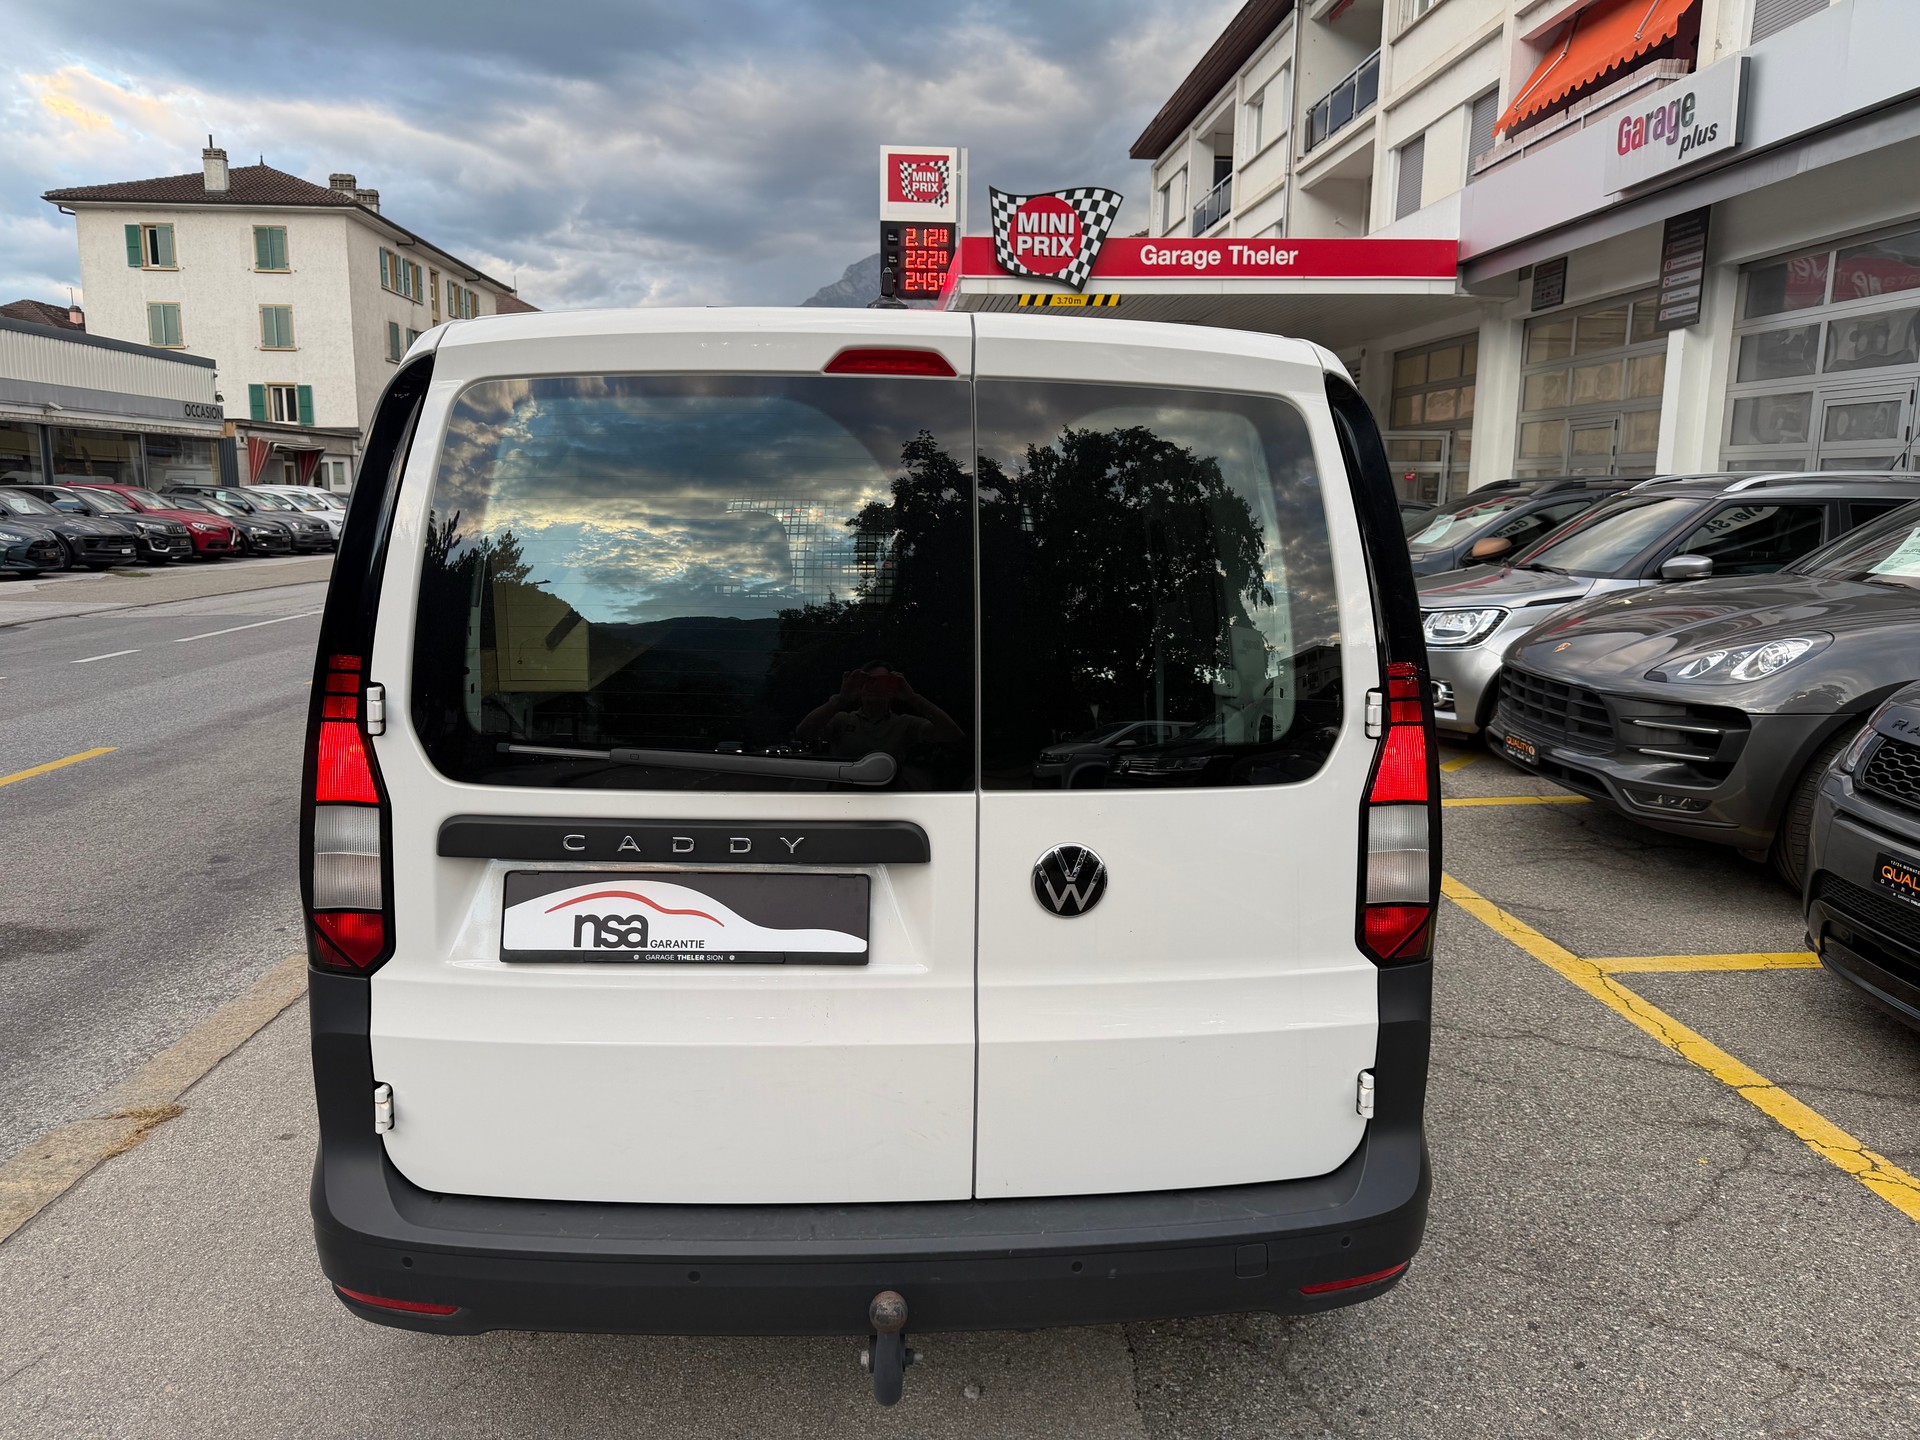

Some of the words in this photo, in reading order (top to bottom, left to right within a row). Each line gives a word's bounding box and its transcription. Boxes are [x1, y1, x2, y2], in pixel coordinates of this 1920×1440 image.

[1617, 91, 1696, 156] Garage
[1678, 122, 1718, 160] plus
[912, 171, 939, 182] MINI
[912, 182, 939, 193] PRIX
[1017, 212, 1075, 234] MINI
[1016, 236, 1075, 257] PRIX
[1140, 244, 1221, 270] Garage
[1228, 245, 1299, 266] Theler
[185, 403, 223, 420] OCCASION
[563, 834, 805, 855] CADDY
[573, 913, 649, 949] nsa
[650, 939, 705, 949] GARANTIE
